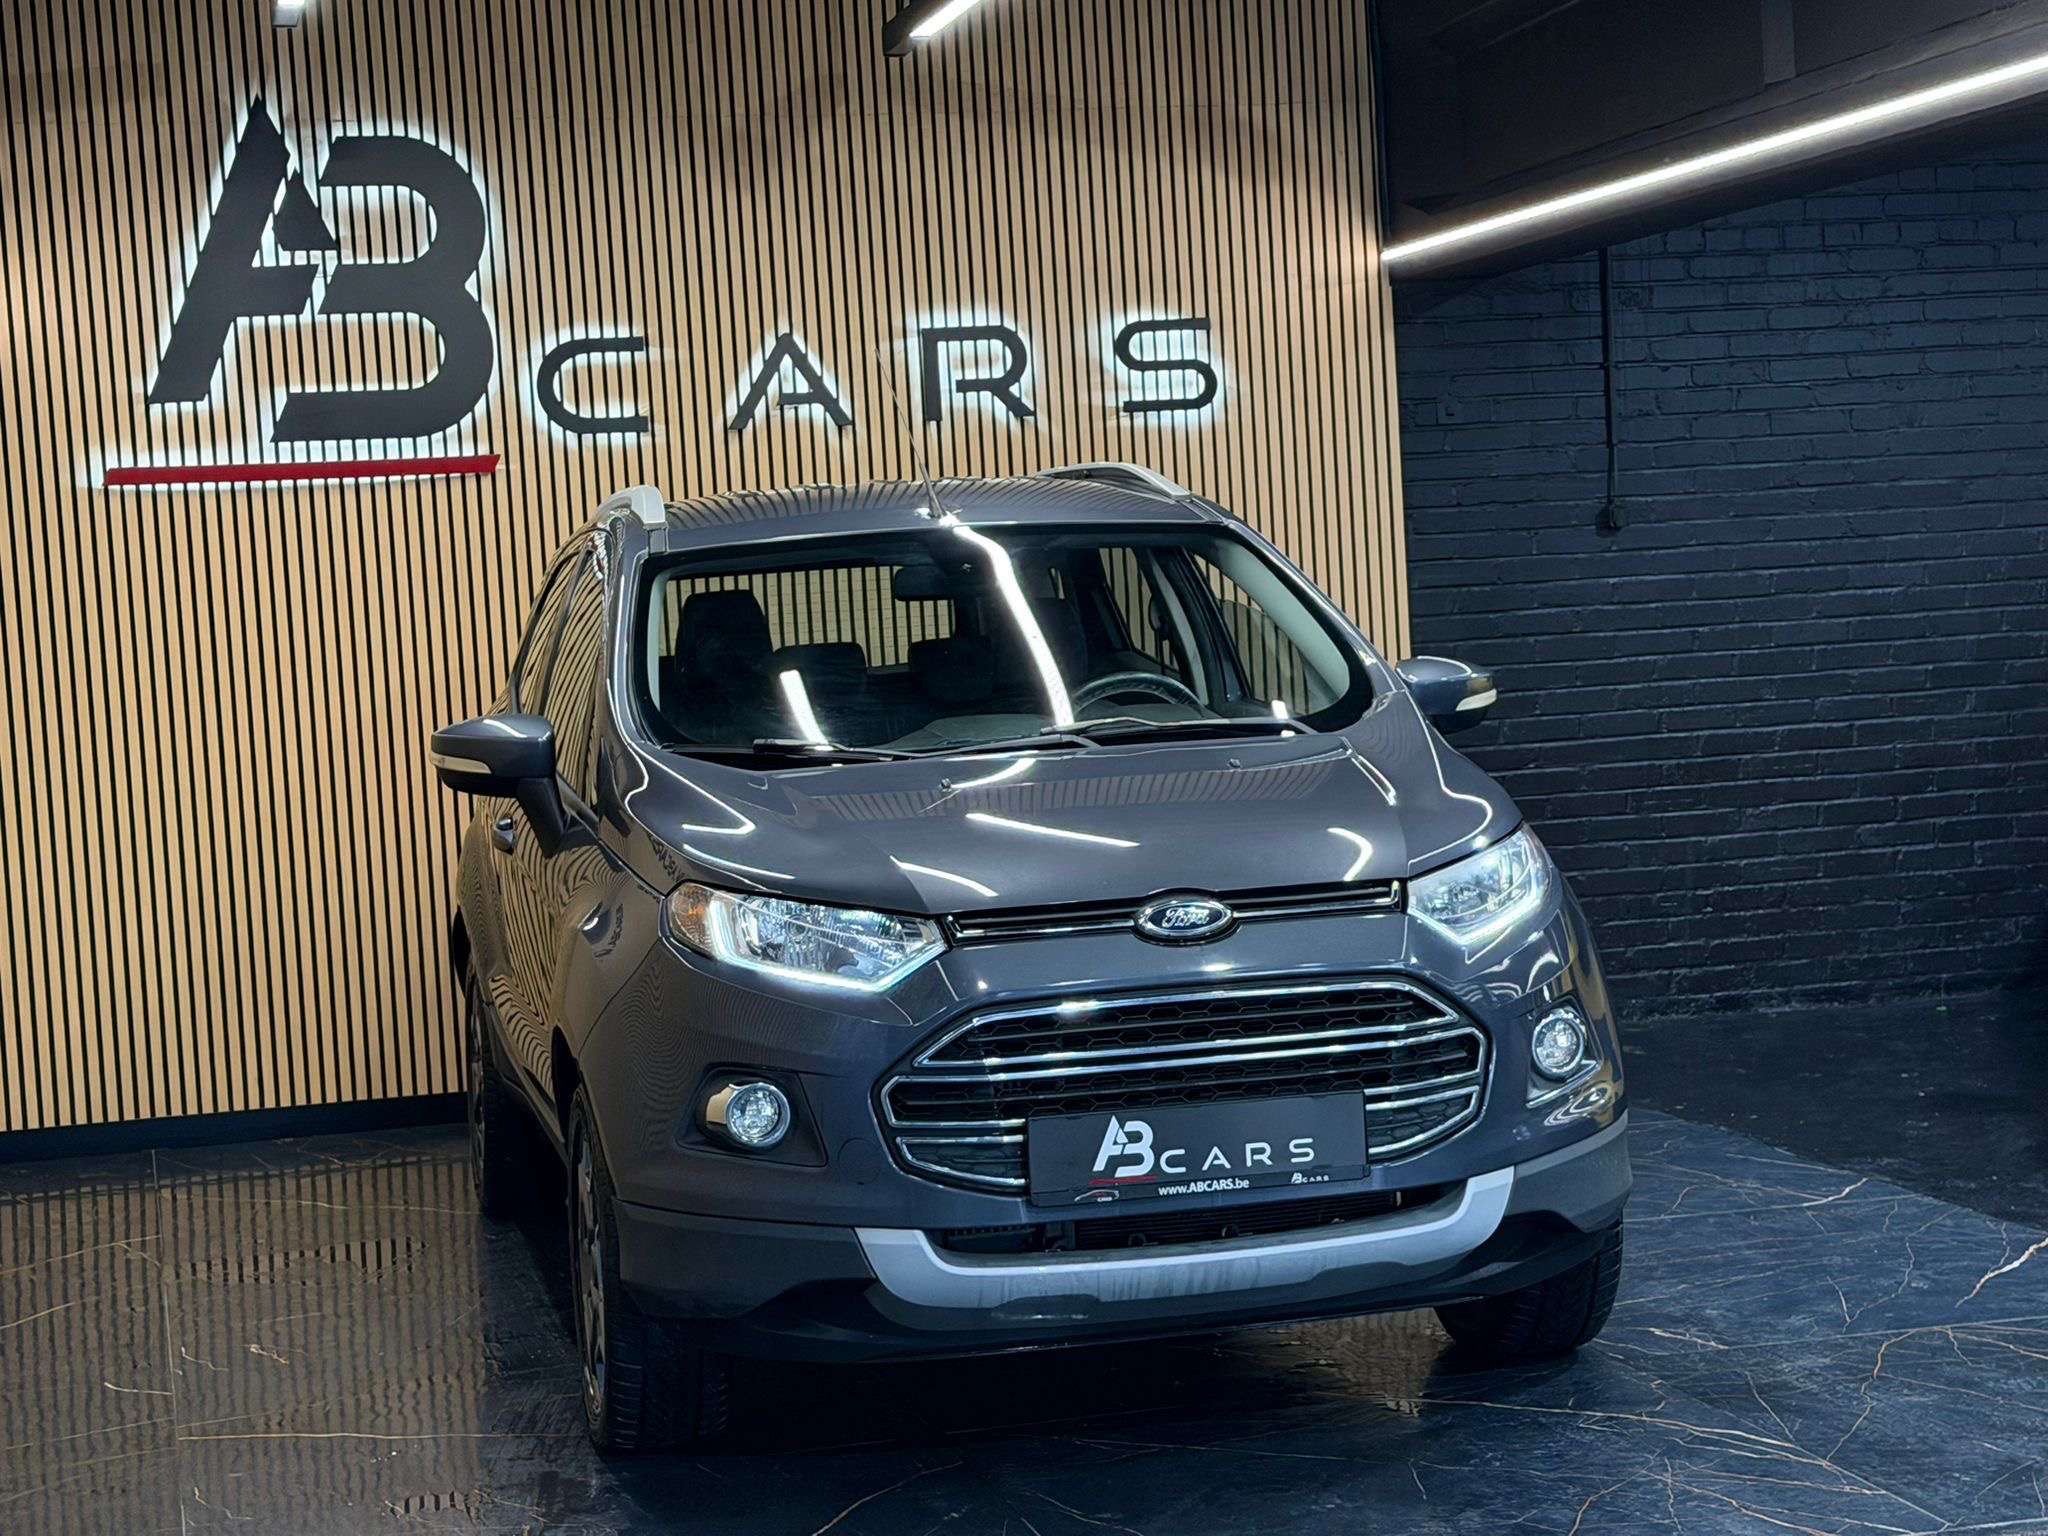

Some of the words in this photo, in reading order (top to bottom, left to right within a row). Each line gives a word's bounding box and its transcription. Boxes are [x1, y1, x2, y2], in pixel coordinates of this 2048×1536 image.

[146, 94, 494, 443] AB
[537, 316, 1218, 434] CARS
[1161, 906, 1210, 929] Ford
[1092, 1114, 1154, 1178] AB
[1159, 1137, 1315, 1174] CARS
[1158, 1177, 1250, 1196] www.ABCARS.be
